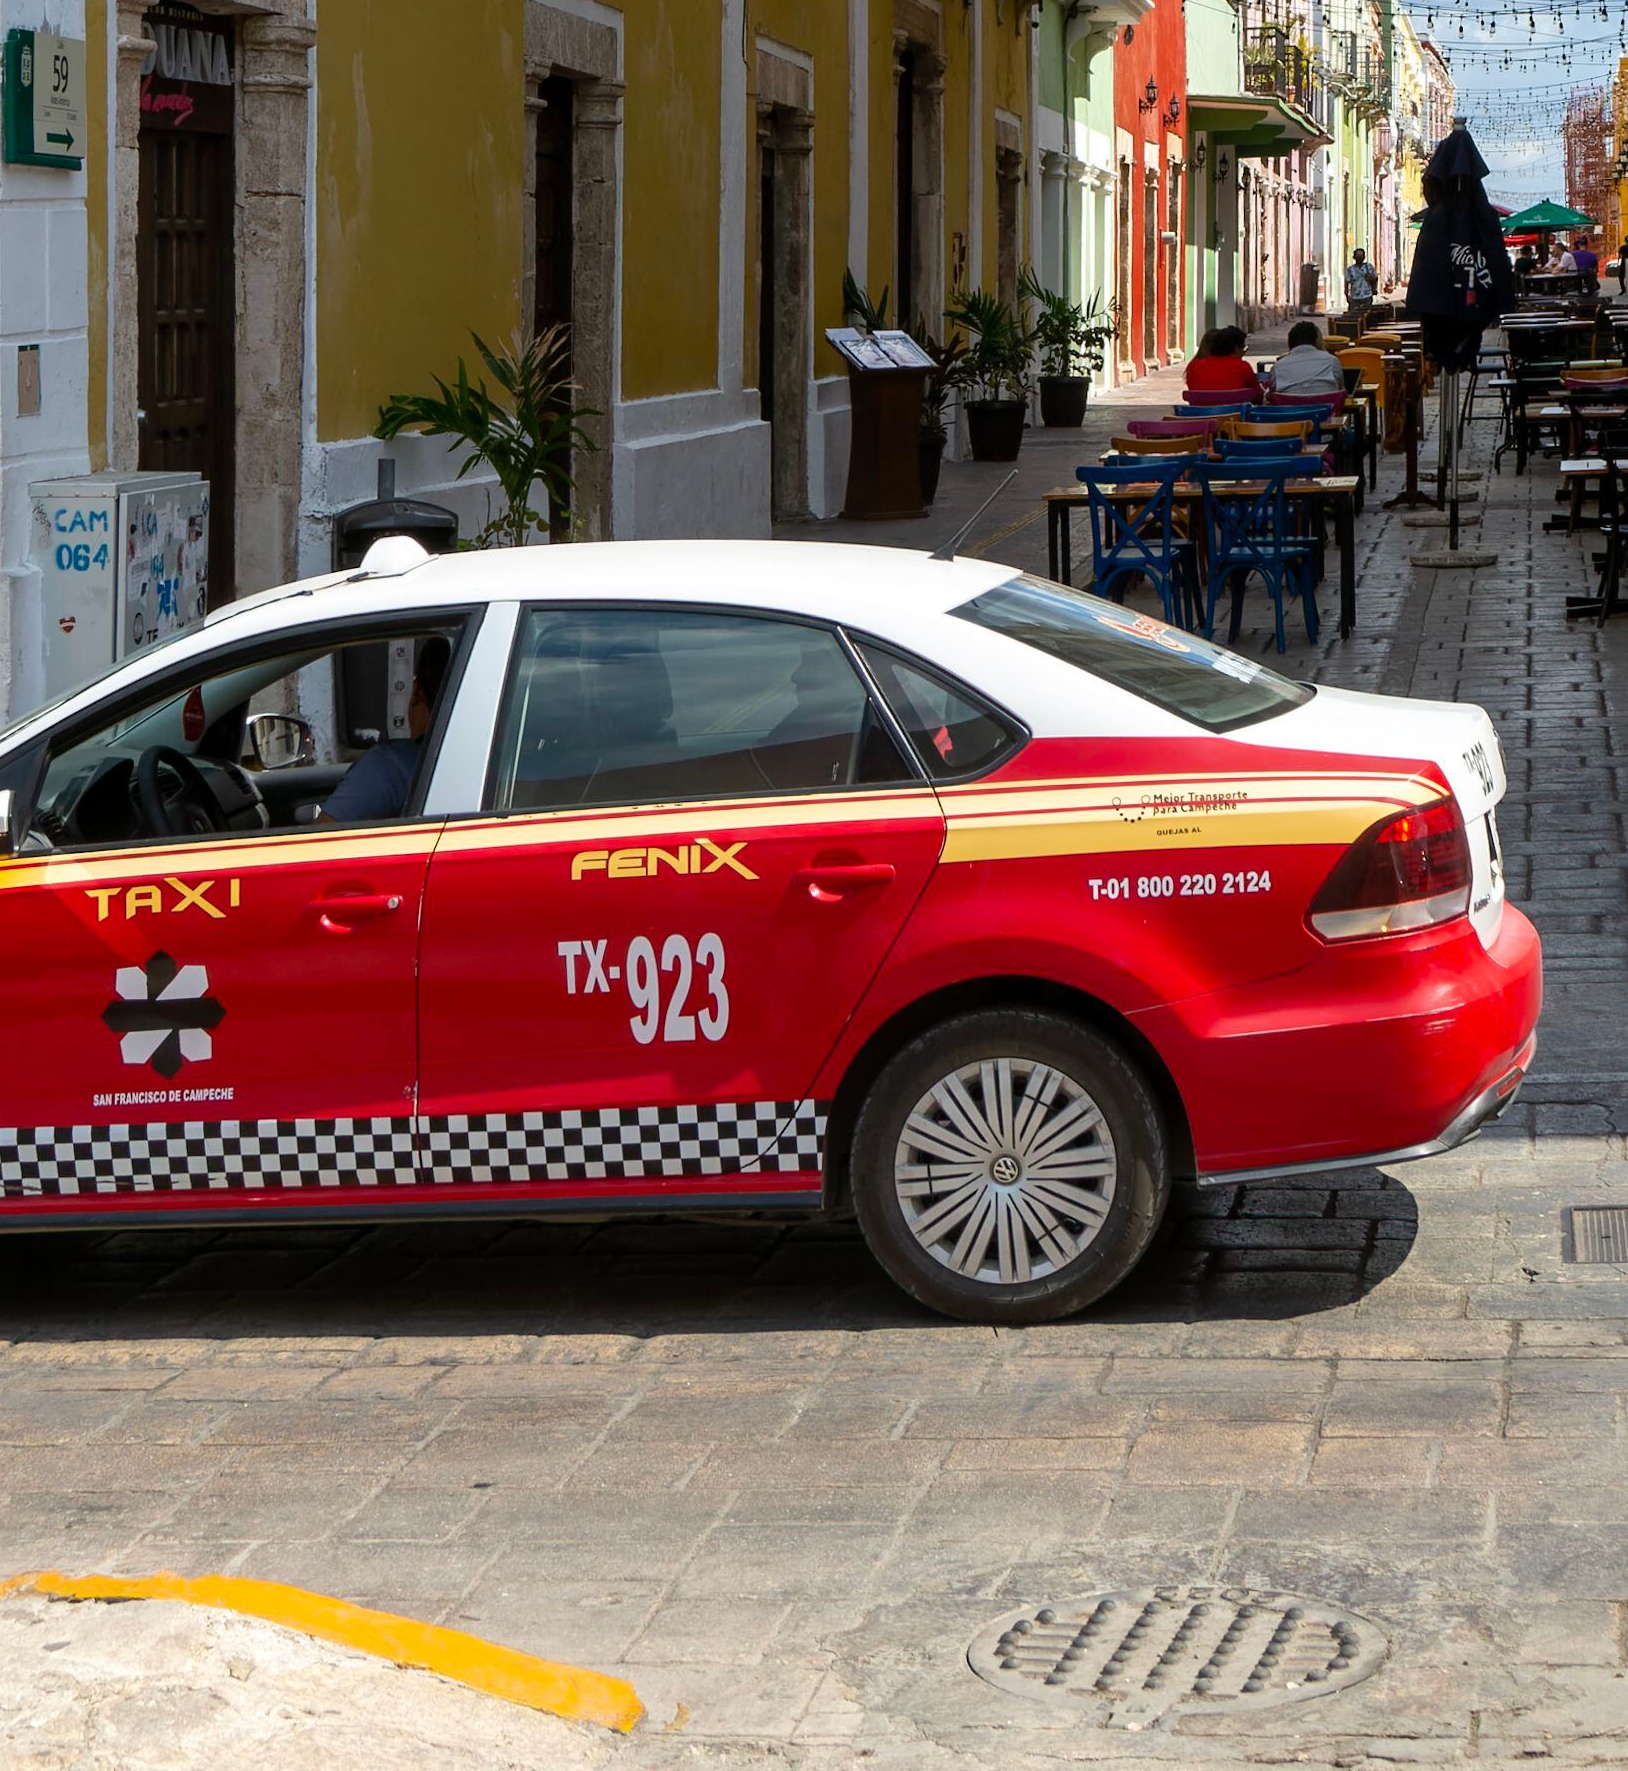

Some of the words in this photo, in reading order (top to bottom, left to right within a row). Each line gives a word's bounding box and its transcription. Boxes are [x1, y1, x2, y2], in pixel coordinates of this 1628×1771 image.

[52, 54, 70, 94] 59
[54, 508, 109, 533] CAM
[55, 543, 110, 572] 064
[1153, 793, 1185, 805] Mejor
[1188, 790, 1248, 803] Transporte
[1153, 804, 1178, 816] para
[1181, 802, 1237, 815] Campeche
[1156, 828, 1189, 837] QUEJAS
[1191, 826, 1202, 834] AL
[571, 838, 760, 880] FENIX
[1088, 877, 1130, 900] T-01
[1137, 876, 1174, 898] 800
[1179, 873, 1217, 896] 220
[1222, 870, 1272, 894] 2124
[84, 877, 241, 921] TAXI
[93, 1093, 112, 1106] SAN
[114, 1090, 167, 1105] FRANCISCO
[168, 1089, 181, 1102] DE
[183, 1087, 234, 1102] CAMPECHE
